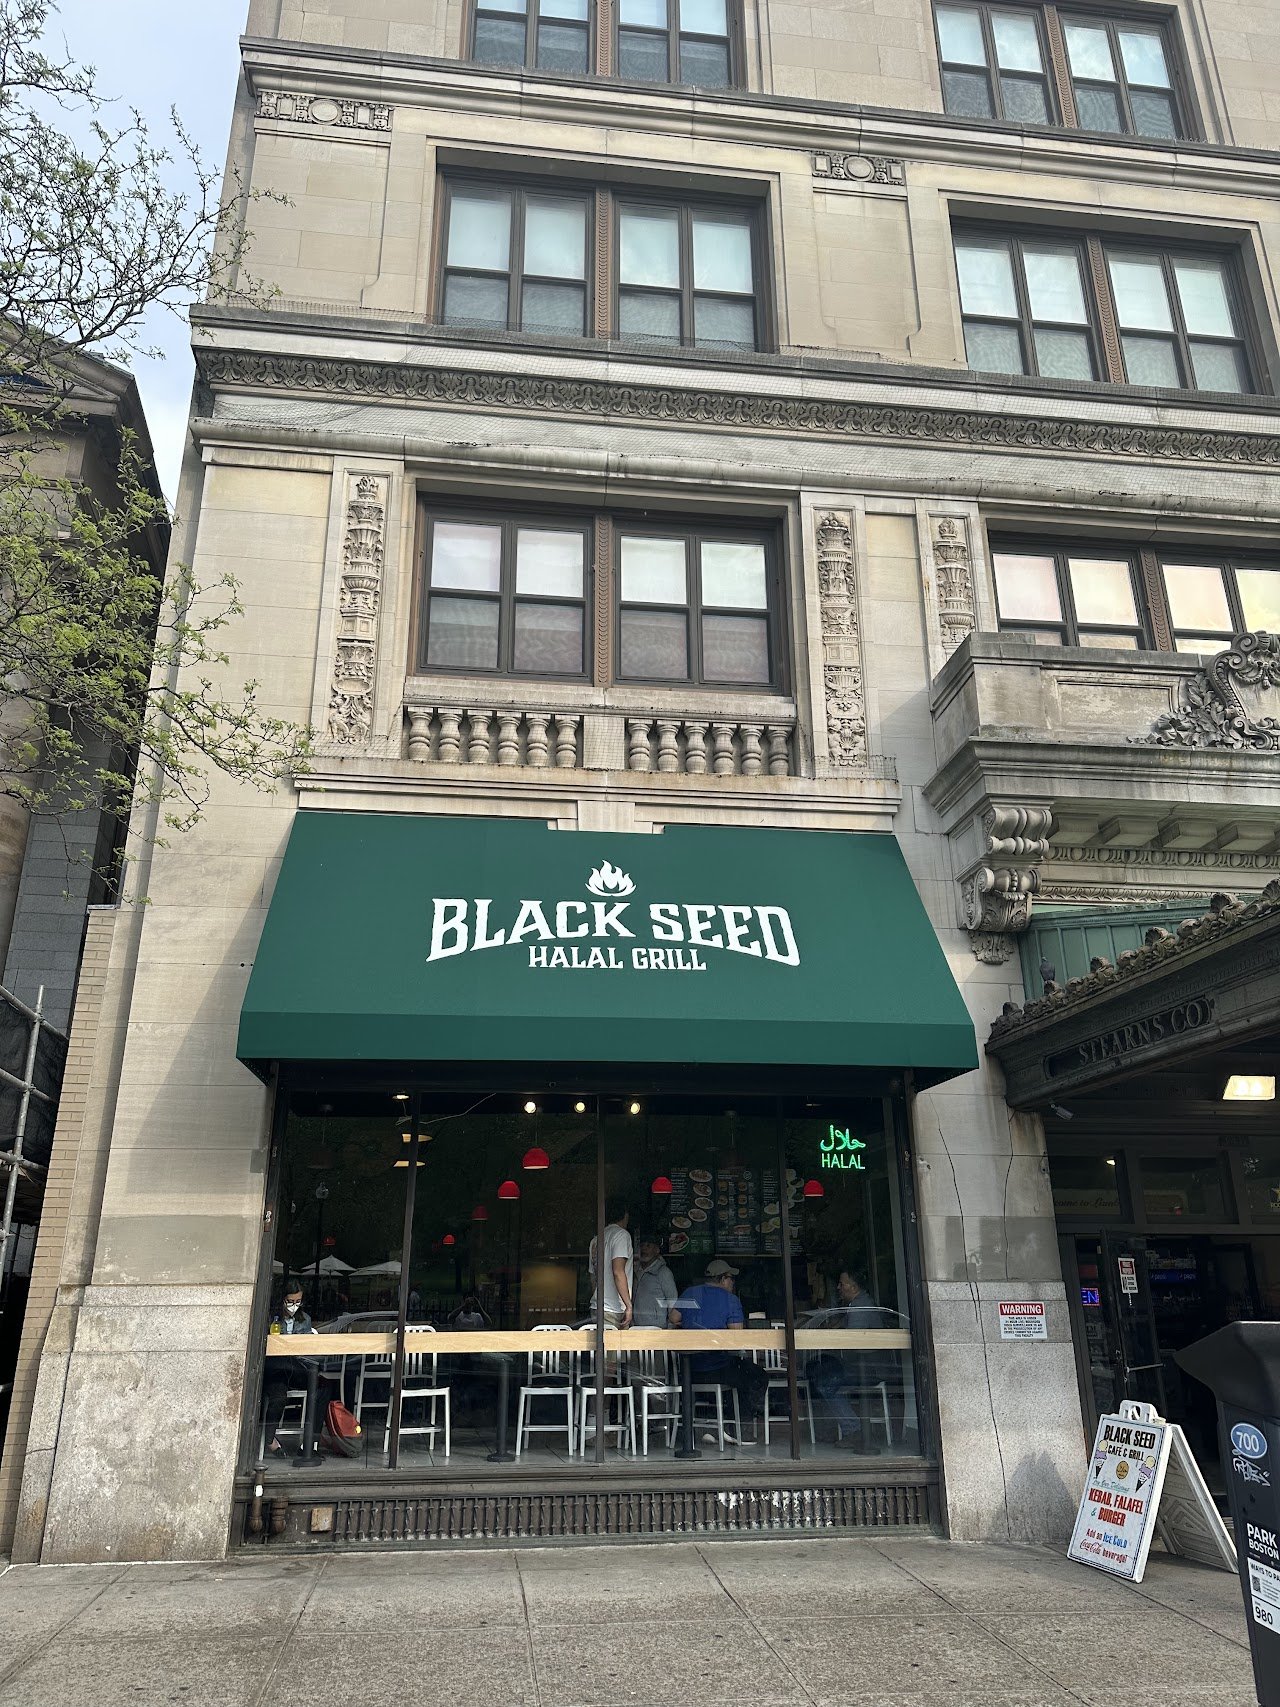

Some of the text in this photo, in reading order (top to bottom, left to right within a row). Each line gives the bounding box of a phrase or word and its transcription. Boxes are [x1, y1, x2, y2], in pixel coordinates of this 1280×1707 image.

[426, 898, 800, 966] BLACK SEED
[528, 945, 707, 970] HALAL GRILL
[1078, 1014, 1165, 1066] STEARNS
[820, 1124, 866, 1151] حلال
[821, 1153, 866, 1170] HALAL
[1001, 1304, 1042, 1314] WARNING
[1103, 1425, 1156, 1449] BLACK SEED
[1236, 1431, 1260, 1452] 700
[1128, 1449, 1144, 1461] GRILL
[1088, 1488, 1144, 1515] KEBAB, FALAFEL
[1097, 1506, 1126, 1527] BURGER
[1246, 1522, 1278, 1549] PARK
[1248, 1538, 1280, 1560] BOSTON
[1250, 1562, 1265, 1575] WAYS
[1265, 1569, 1273, 1578] TO
[1255, 1606, 1273, 1625] 980
